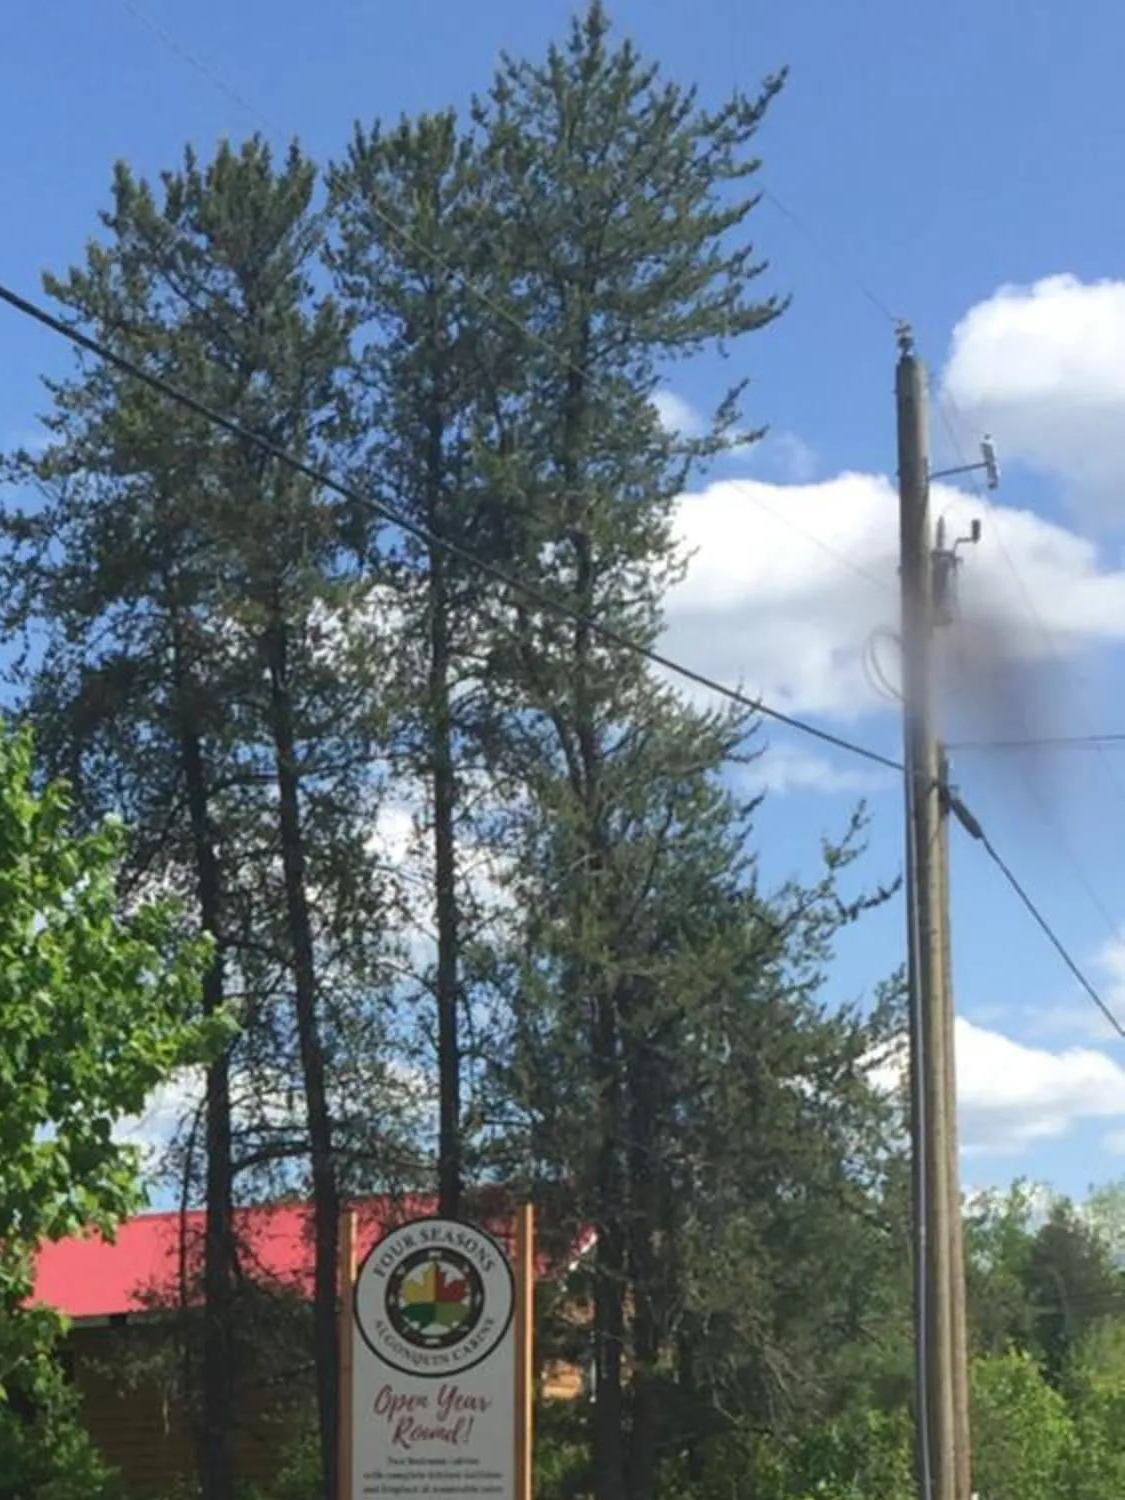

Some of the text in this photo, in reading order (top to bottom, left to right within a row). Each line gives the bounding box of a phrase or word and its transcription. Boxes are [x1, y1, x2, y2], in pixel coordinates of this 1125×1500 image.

[373, 1227, 496, 1278] FOUR SEASONS
[375, 1319, 450, 1366] ALGONQUIN
[373, 1384, 491, 1422] Open Year
[390, 1415, 475, 1450] Round!
